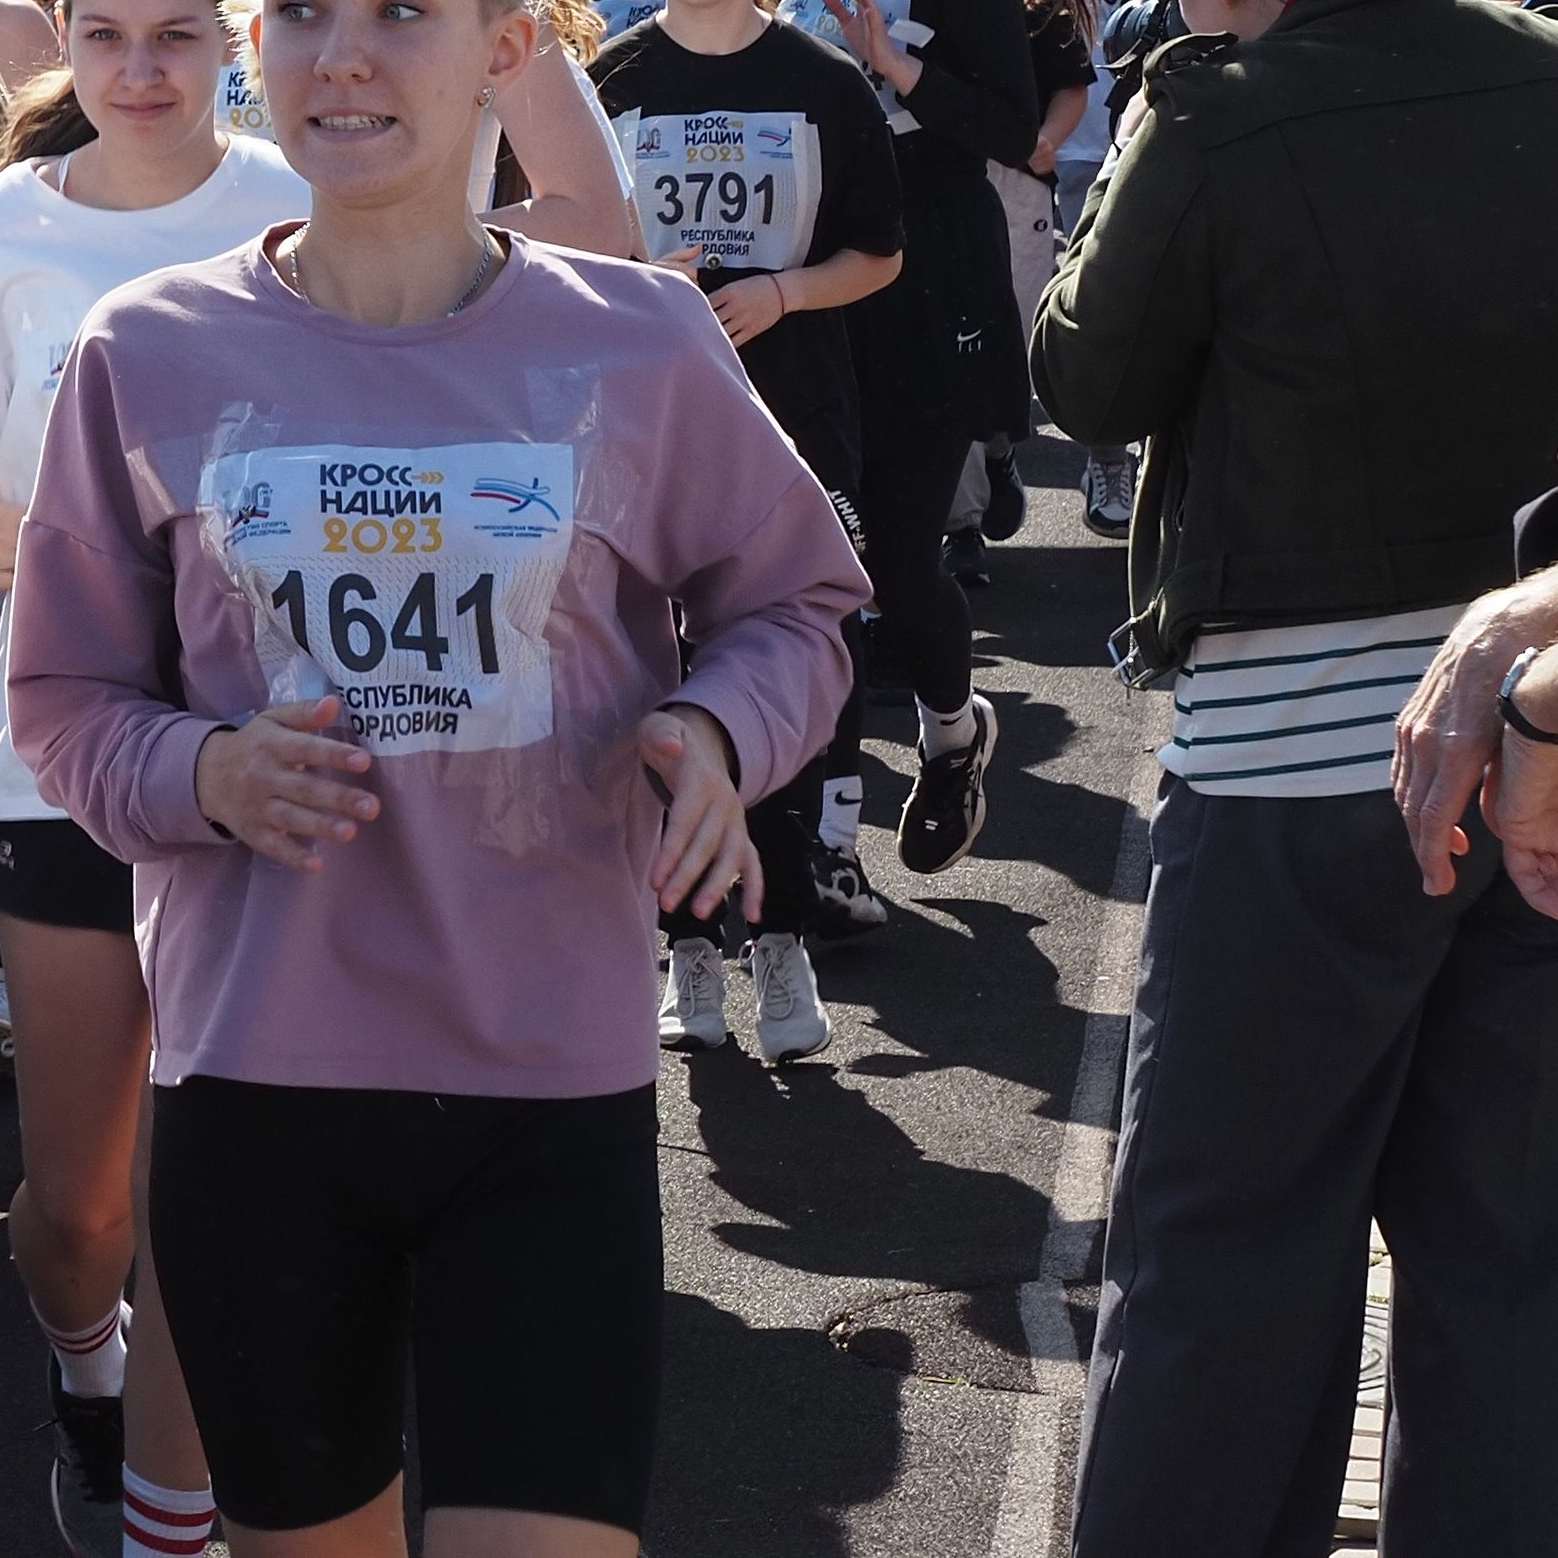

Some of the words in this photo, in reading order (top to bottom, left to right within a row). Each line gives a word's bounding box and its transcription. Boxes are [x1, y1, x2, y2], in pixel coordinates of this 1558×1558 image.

[685, 116, 728, 132] КРОСС
[685, 131, 744, 146] НАЦИИ
[687, 145, 745, 164] 2023
[654, 172, 774, 225] 3791
[681, 230, 755, 242] РЕСПУБЛИКА
[687, 243, 750, 257] РДОВИЯ
[320, 463, 413, 488] КРОСС
[320, 489, 443, 518] НАЦИИ
[827, 489, 866, 553] FF-WHIT
[322, 517, 444, 555] 2023
[271, 569, 501, 675] 1641
[337, 683, 473, 710] СПУБЛИКА
[351, 710, 459, 743] ОРДОВИЯ
